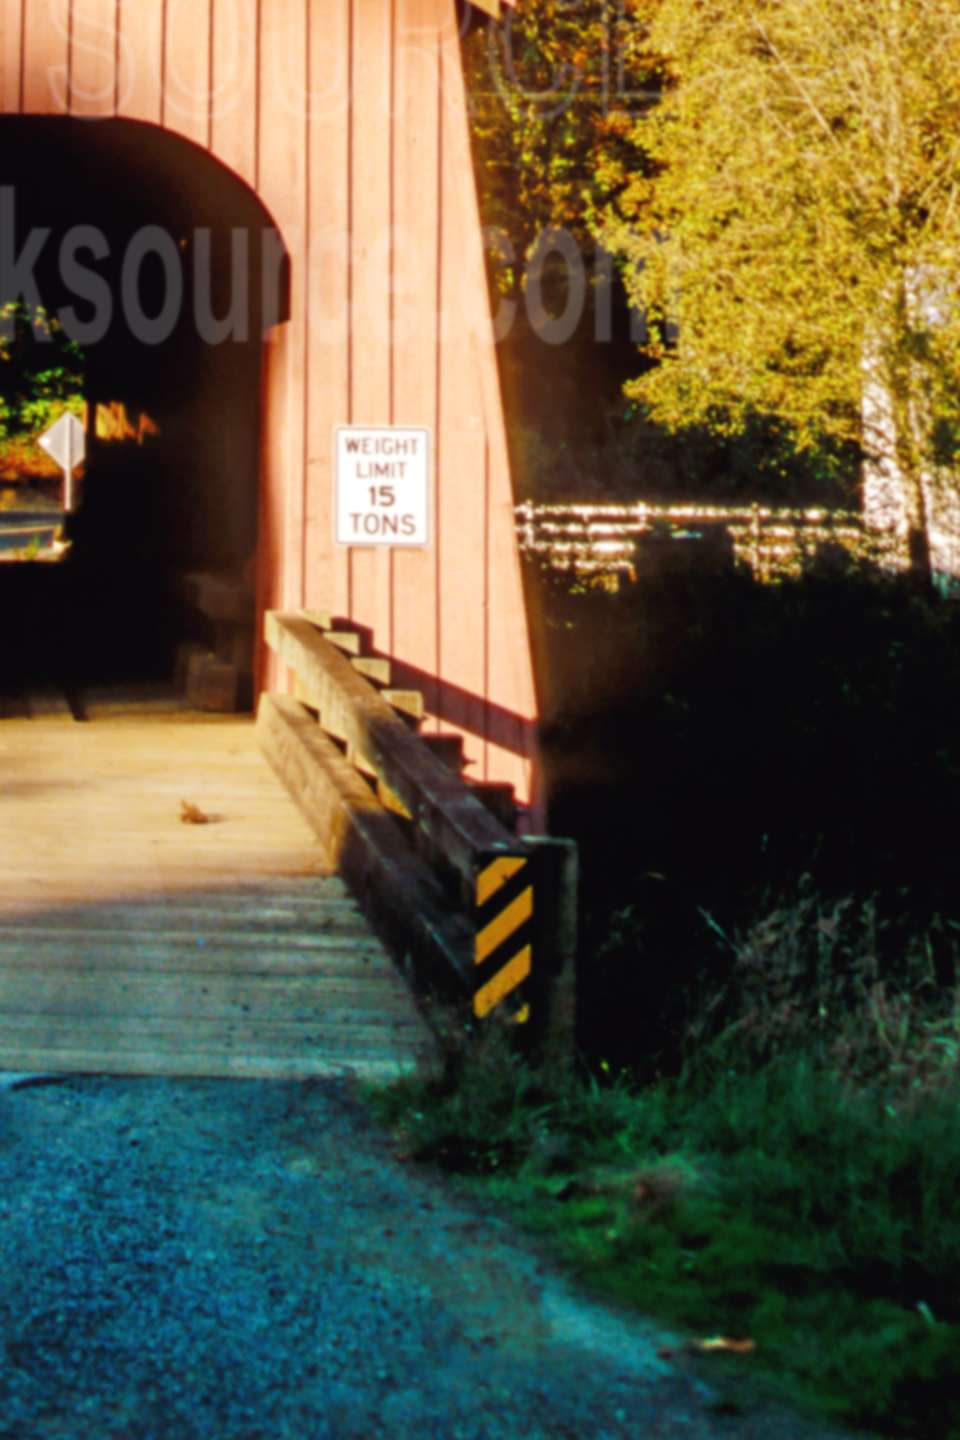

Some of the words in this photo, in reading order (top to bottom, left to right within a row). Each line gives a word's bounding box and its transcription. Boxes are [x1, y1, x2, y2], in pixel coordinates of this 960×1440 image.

[345, 437, 418, 455] WEIGHT
[355, 461, 406, 479] LIMIT
[368, 484, 396, 508] 15
[350, 512, 417, 536] TONS
